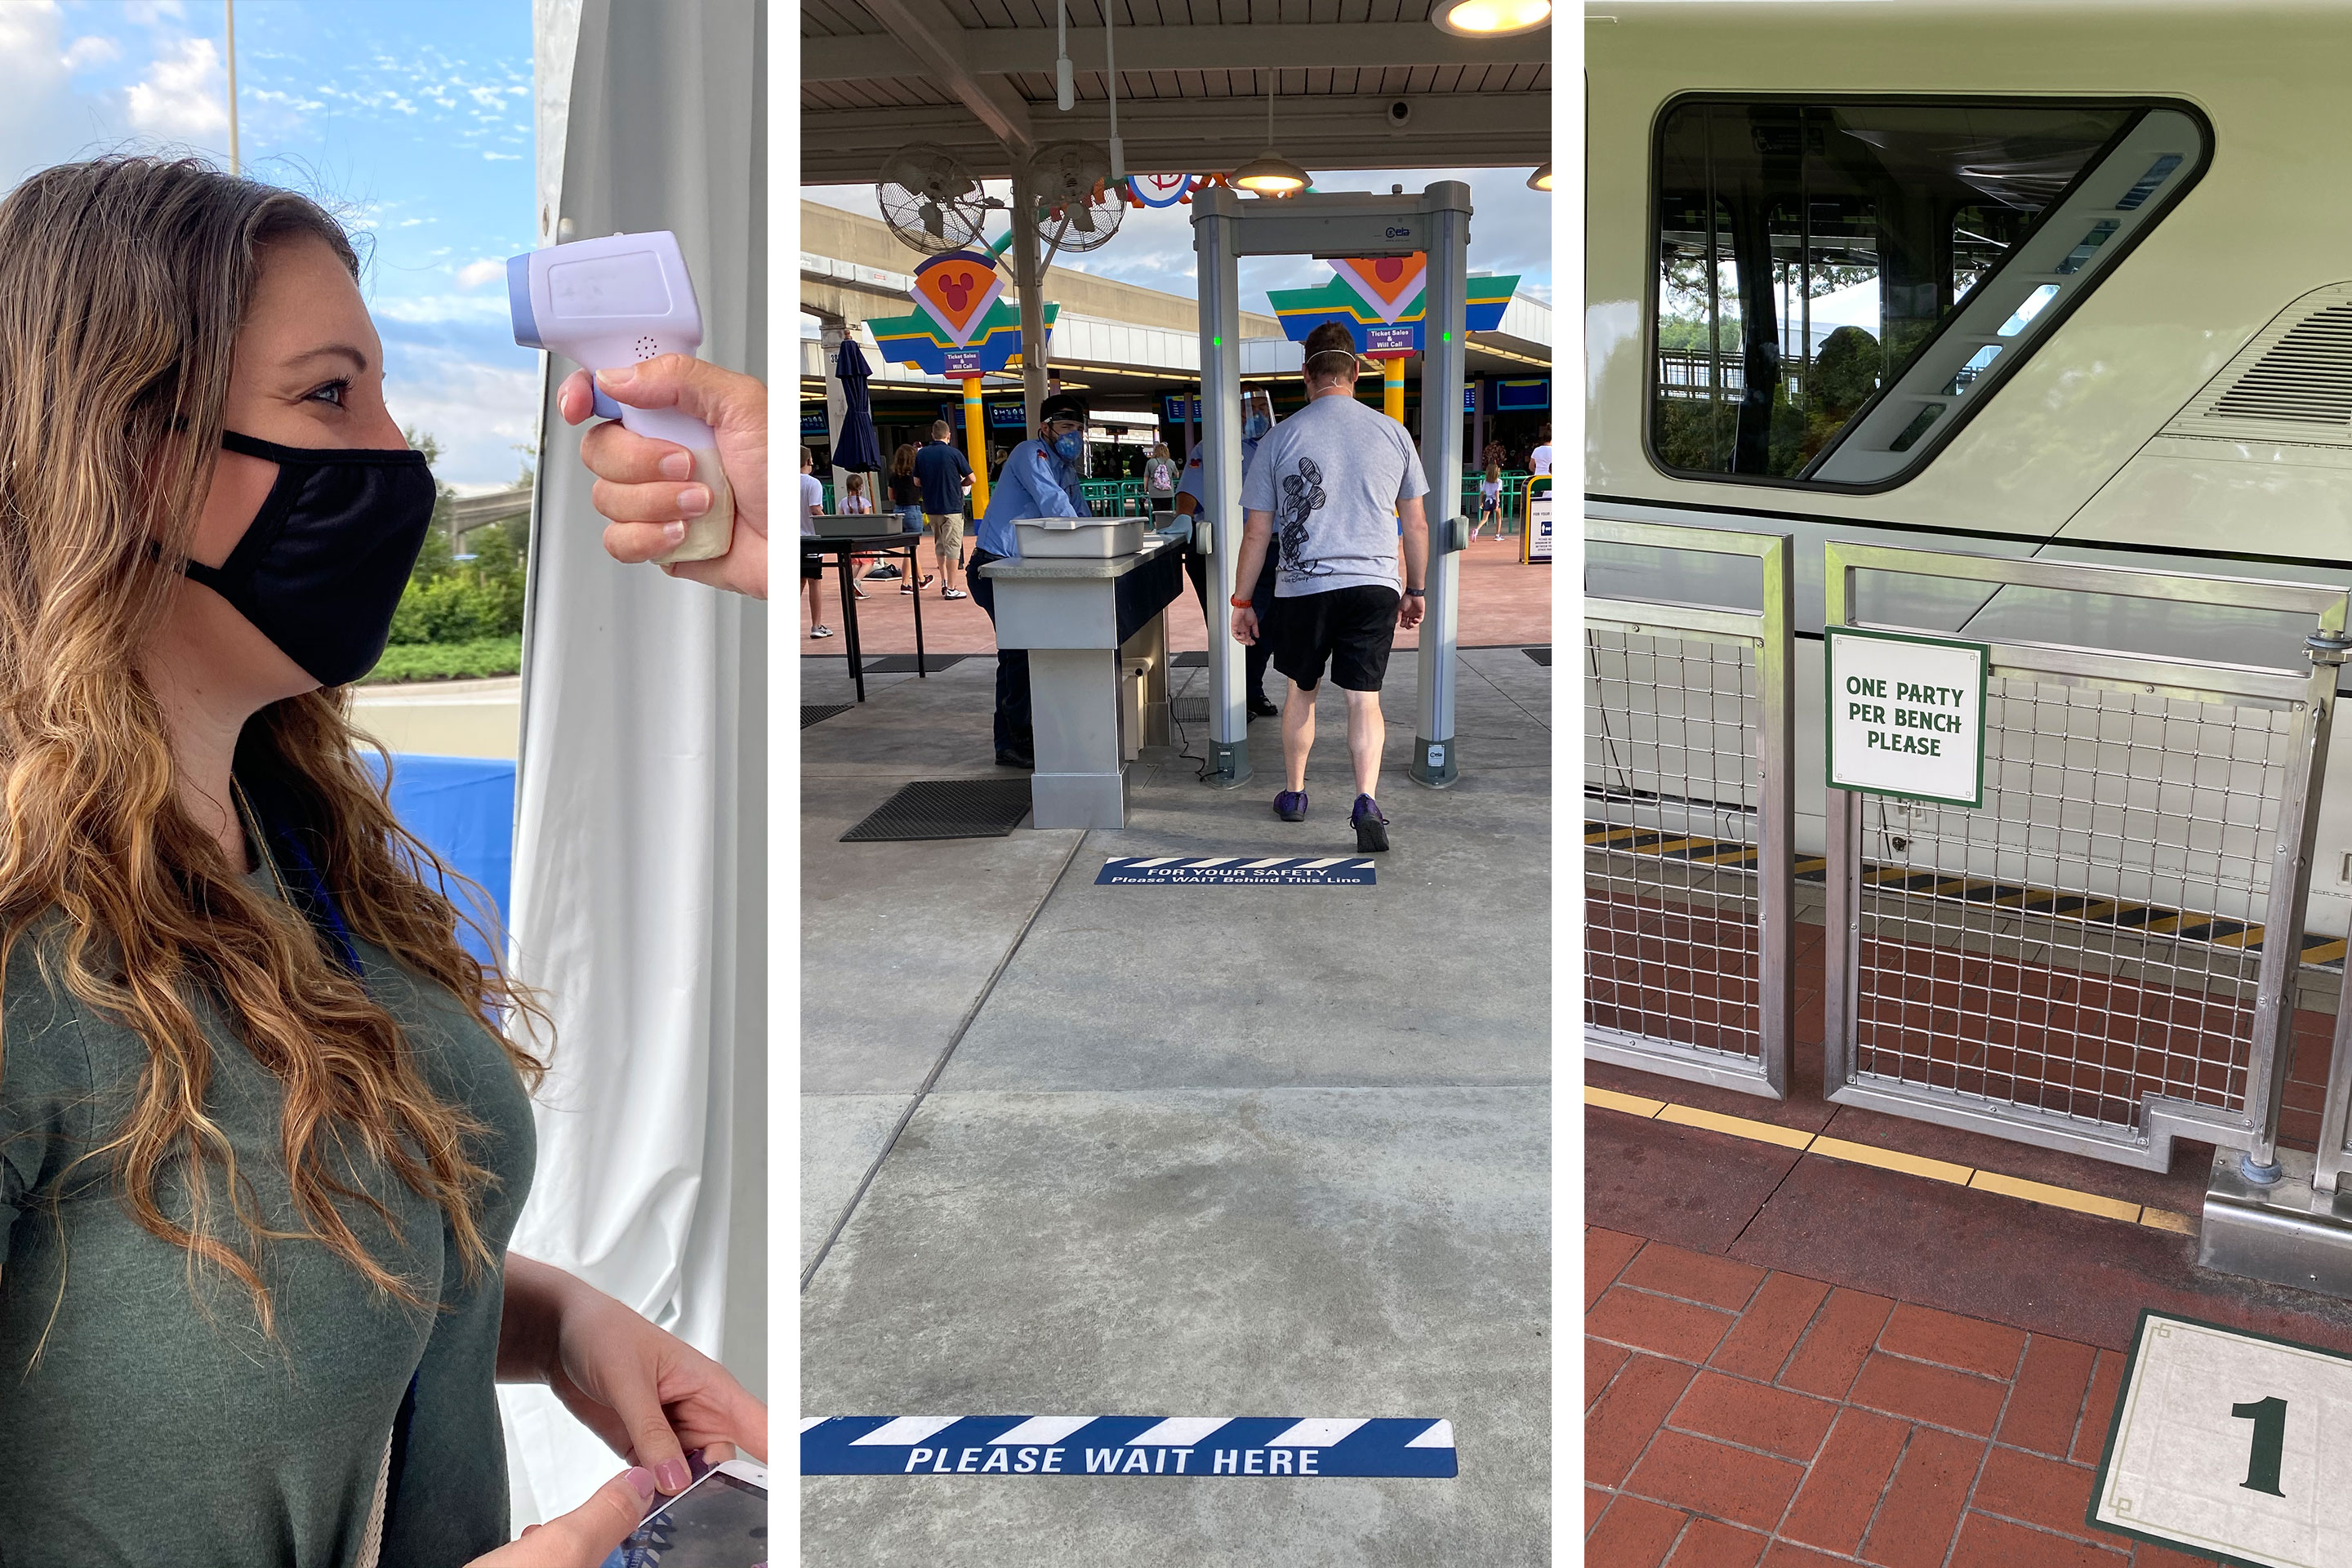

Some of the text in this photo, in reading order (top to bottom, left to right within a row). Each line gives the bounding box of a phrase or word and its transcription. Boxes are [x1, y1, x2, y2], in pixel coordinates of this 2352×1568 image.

[1846, 675, 1964, 707] ONE PARTY
[1849, 702, 1962, 733] PER BENCH
[1867, 731, 1941, 757] PLEASE
[904, 1447, 1319, 1475] PLEASE WAIT HERE
[2231, 1396, 2288, 1499] 1
